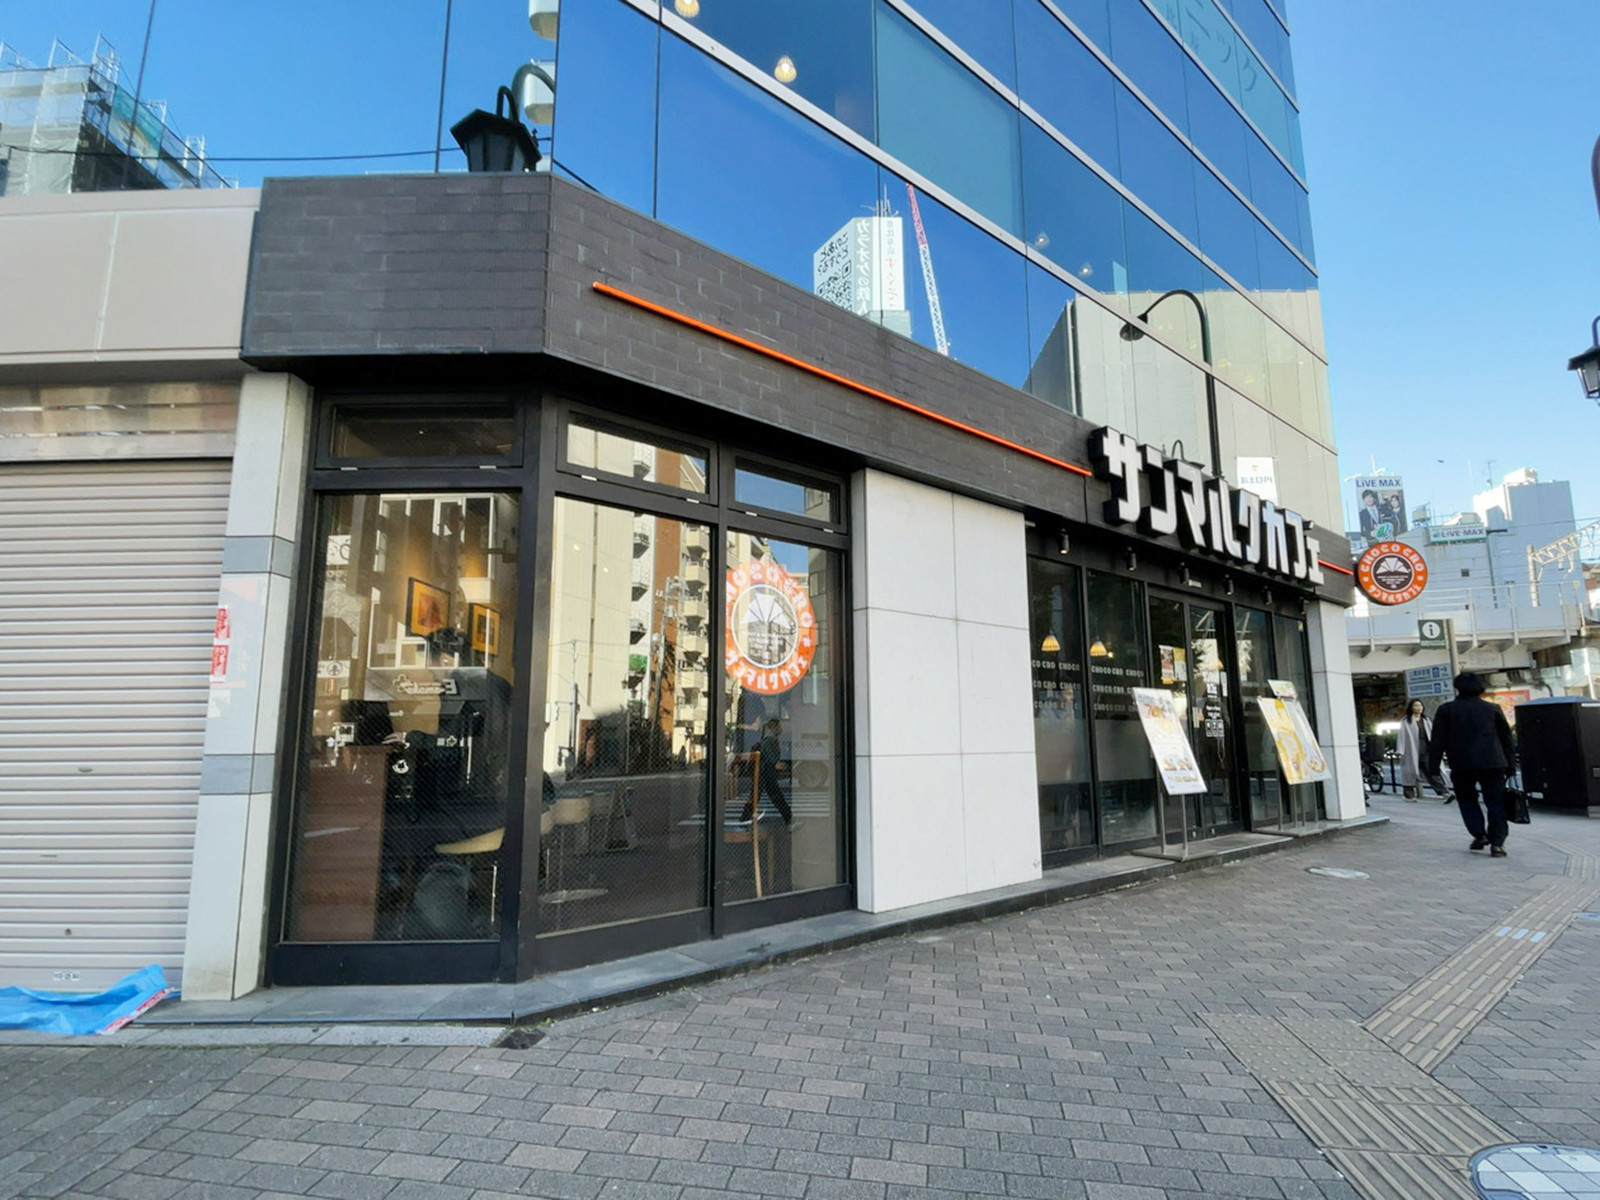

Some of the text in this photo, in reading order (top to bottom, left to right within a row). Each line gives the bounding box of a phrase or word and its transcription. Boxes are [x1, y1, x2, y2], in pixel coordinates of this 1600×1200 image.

[1379, 479, 1401, 487] MAX
[1101, 426, 1325, 587] サンマルクカフェ
[1463, 528, 1484, 537] MAX
[1360, 543, 1400, 573] CHOCO
